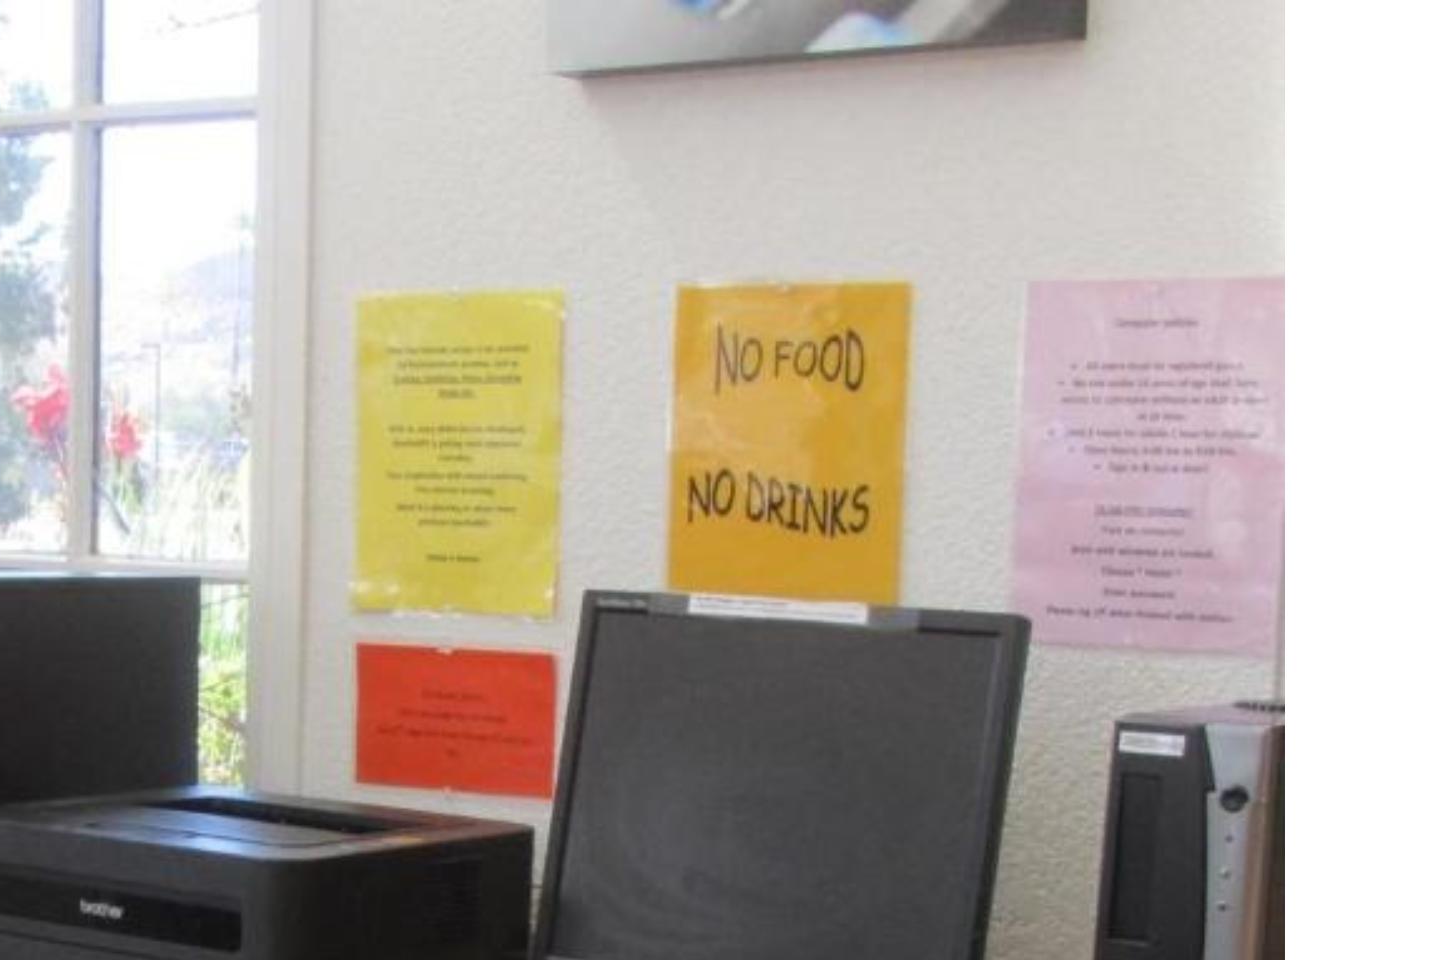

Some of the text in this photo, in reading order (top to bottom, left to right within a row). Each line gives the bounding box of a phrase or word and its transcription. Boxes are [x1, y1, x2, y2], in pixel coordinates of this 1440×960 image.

[714, 320, 864, 396] NO FOOD
[686, 468, 870, 538] NO DRINKS
[79, 897, 123, 920] brother
